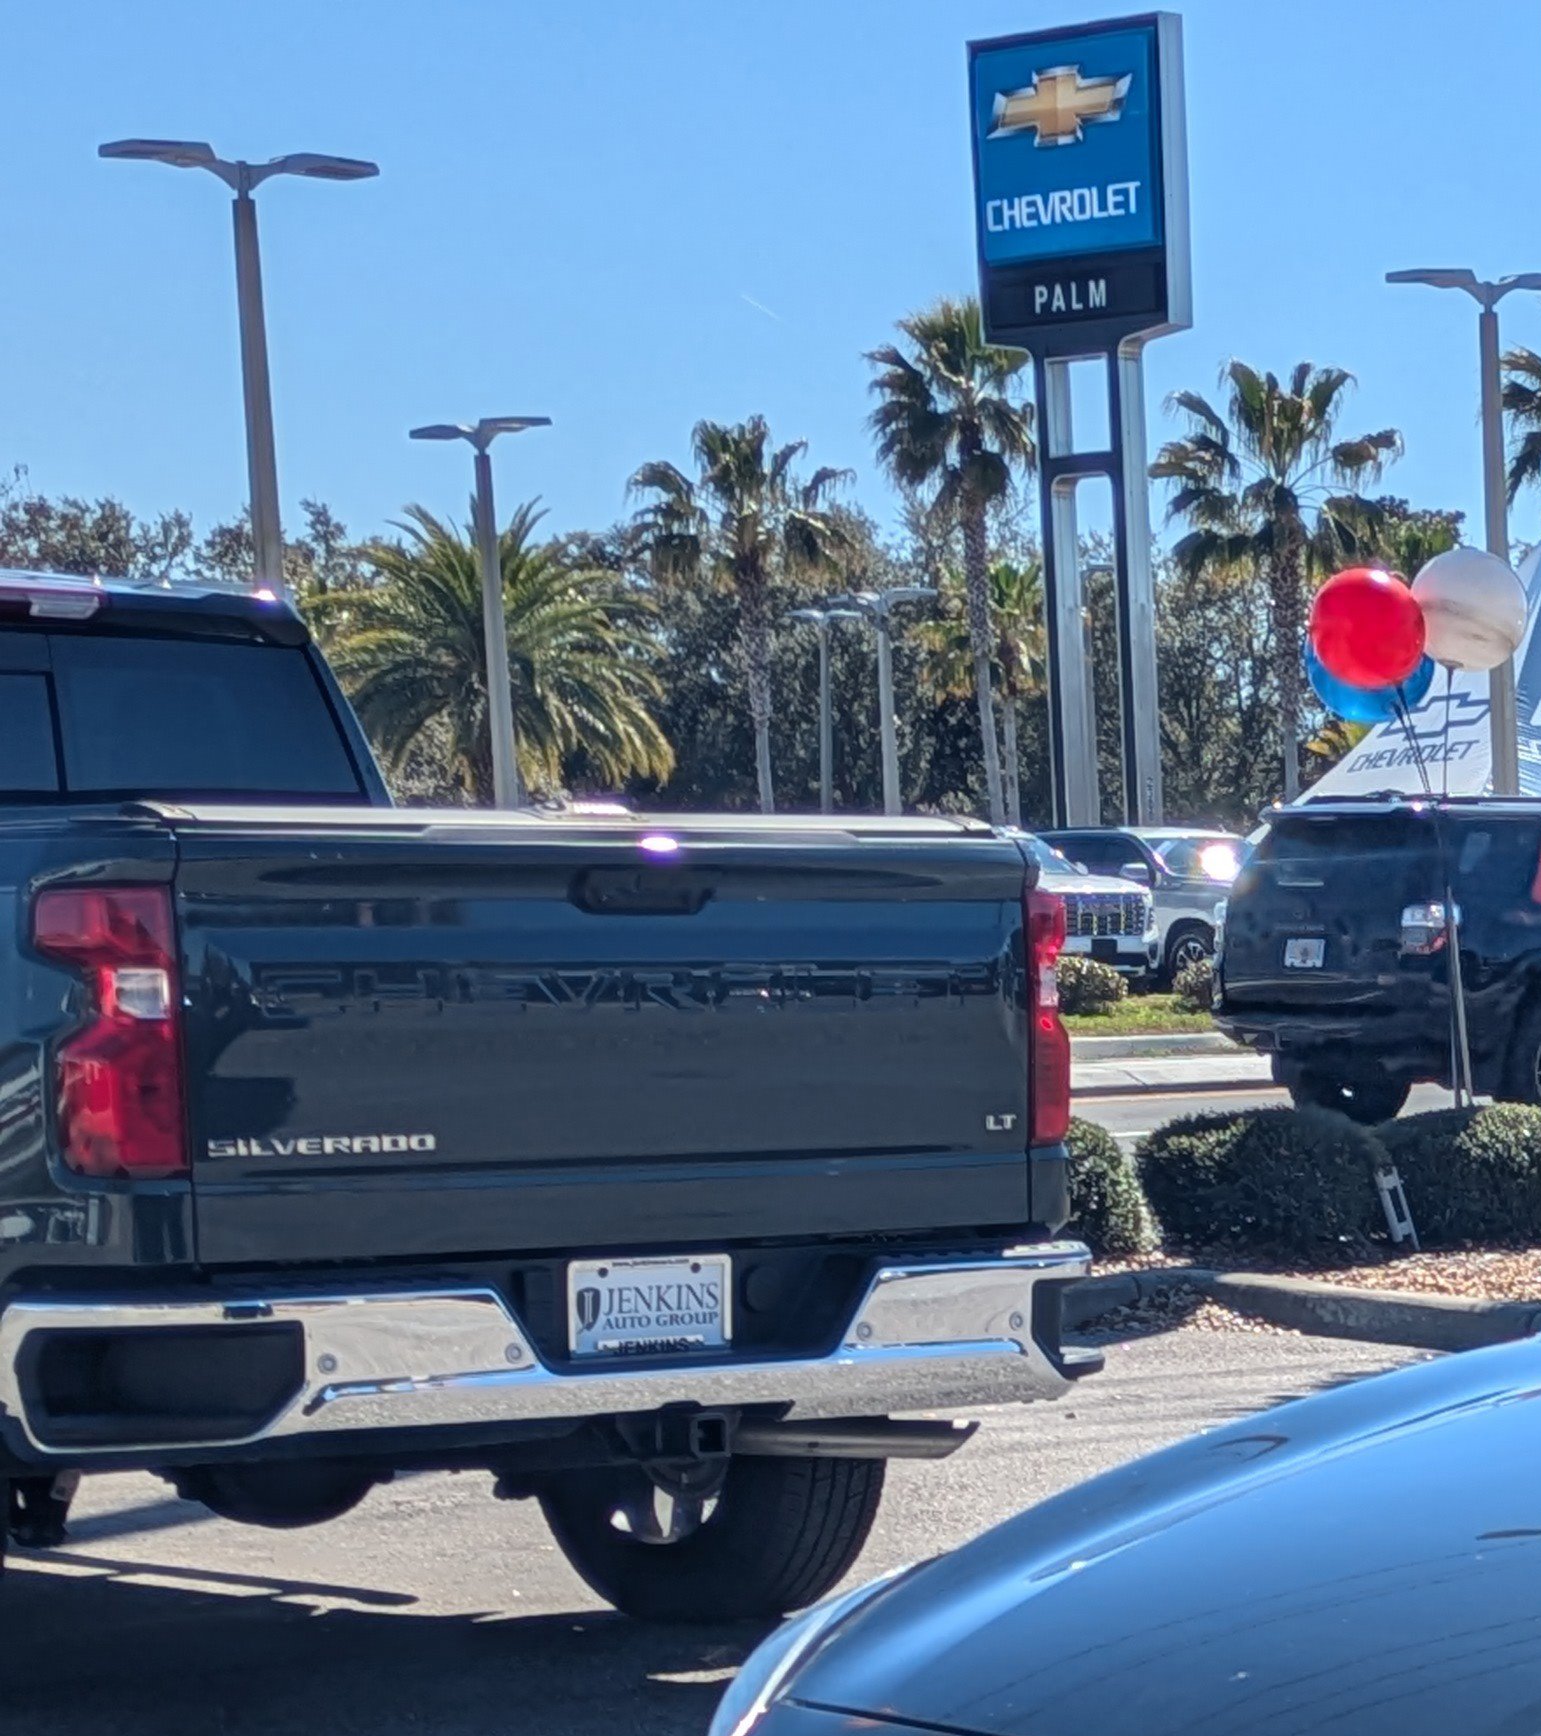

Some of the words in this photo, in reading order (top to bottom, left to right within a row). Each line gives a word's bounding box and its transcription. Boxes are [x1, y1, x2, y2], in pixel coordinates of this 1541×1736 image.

[985, 181, 1141, 232] CHEVROLET
[1034, 279, 1107, 314] PALM
[1347, 739, 1480, 773] CHEVROLET
[986, 1114, 1017, 1130] LT
[208, 1134, 436, 1158] SILVERADO
[603, 1281, 719, 1316] JENKINS
[603, 1316, 650, 1331] AUTO
[656, 1311, 719, 1328] GROUP
